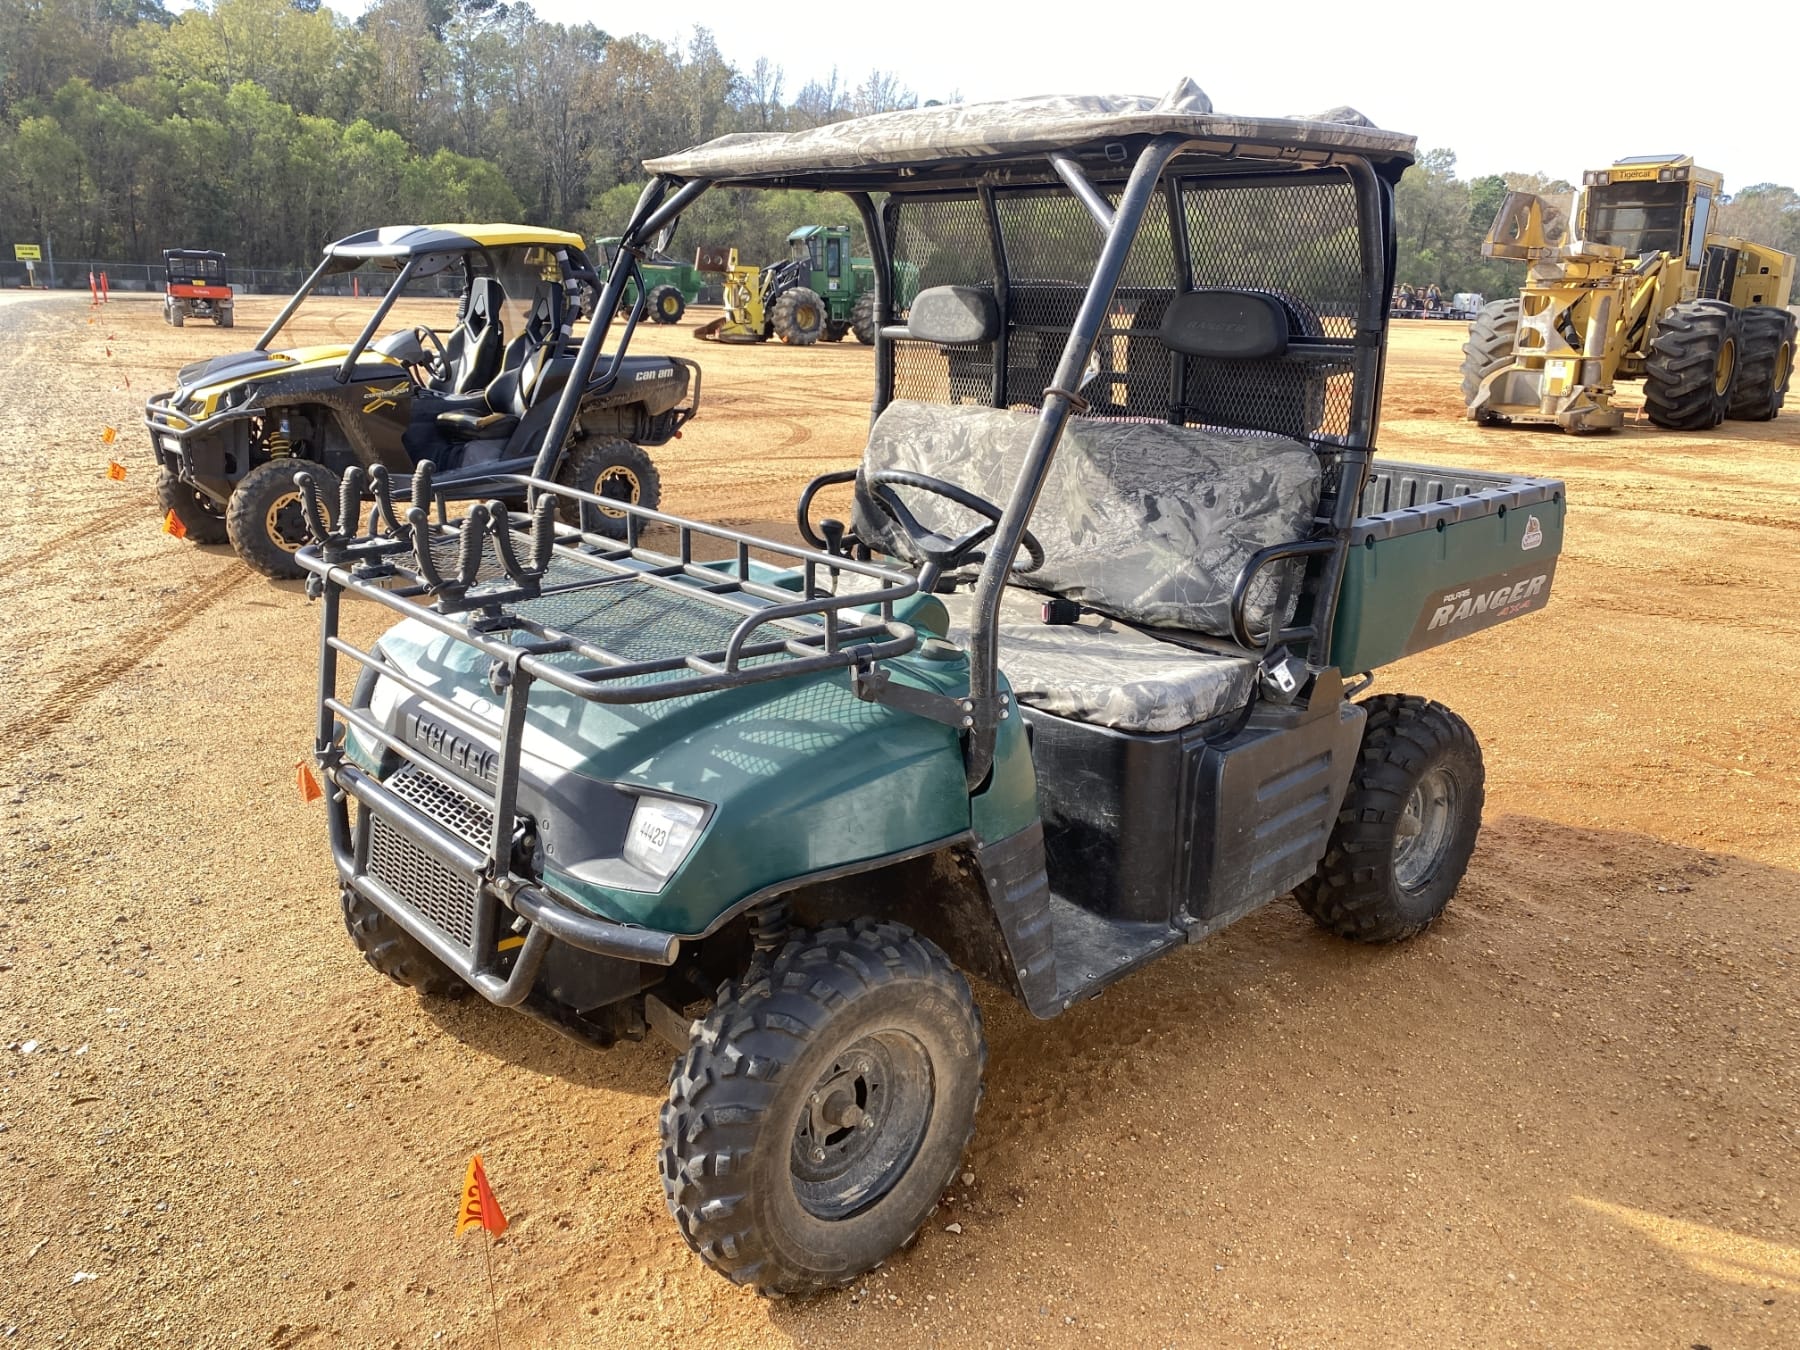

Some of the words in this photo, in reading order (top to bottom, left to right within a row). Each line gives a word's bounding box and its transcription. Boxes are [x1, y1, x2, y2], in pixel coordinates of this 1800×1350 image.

[1427, 574, 1547, 631] RANGER
[1443, 588, 1471, 602] POLARIS
[640, 821, 666, 847] 44423
